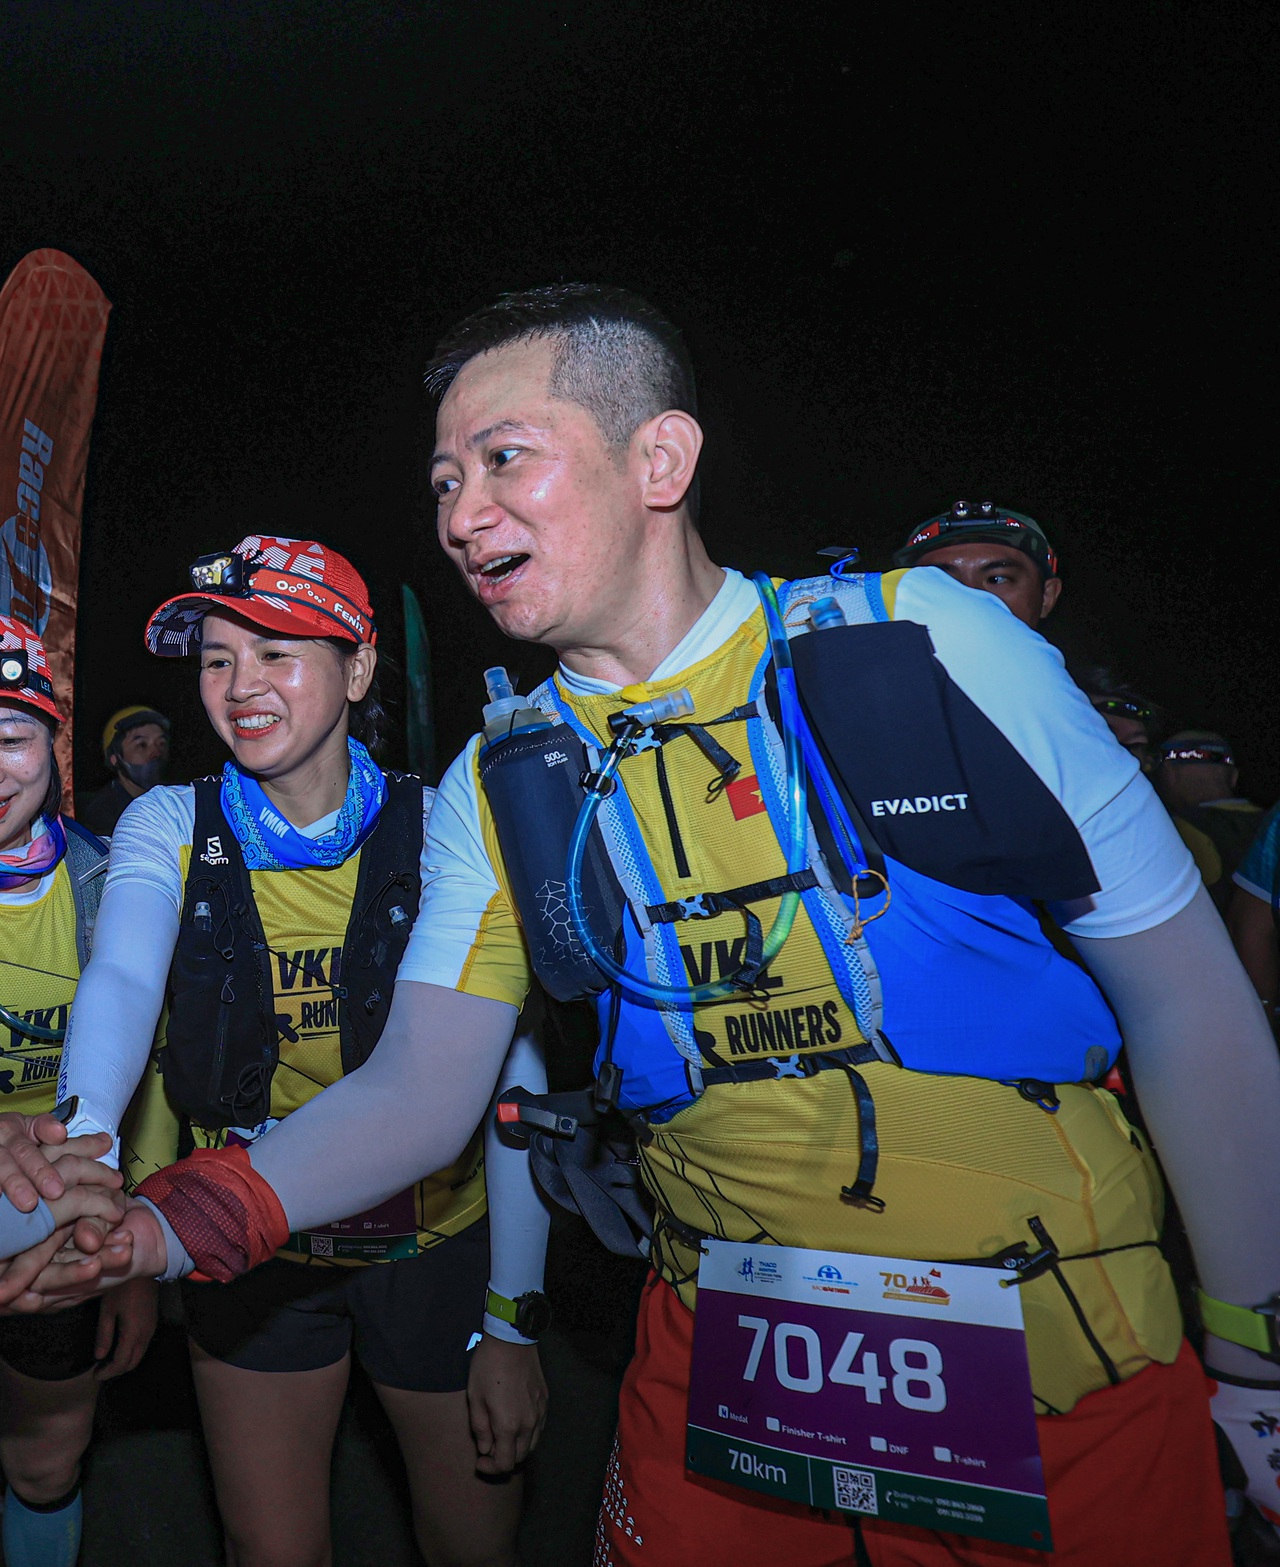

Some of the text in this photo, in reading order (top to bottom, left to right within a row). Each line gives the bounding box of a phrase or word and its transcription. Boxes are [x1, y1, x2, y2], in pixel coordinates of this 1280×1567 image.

[333, 602, 365, 634] FENIX
[871, 793, 969, 817] EVADICT
[258, 806, 291, 839] VMM
[725, 1000, 842, 1055] RUNNERS
[879, 1272, 908, 1289] 70
[737, 1314, 948, 1413] 7048
[781, 1424, 848, 1446] Finisher T-shirt
[889, 1443, 910, 1456] DNF
[727, 1447, 787, 1485] 70km
